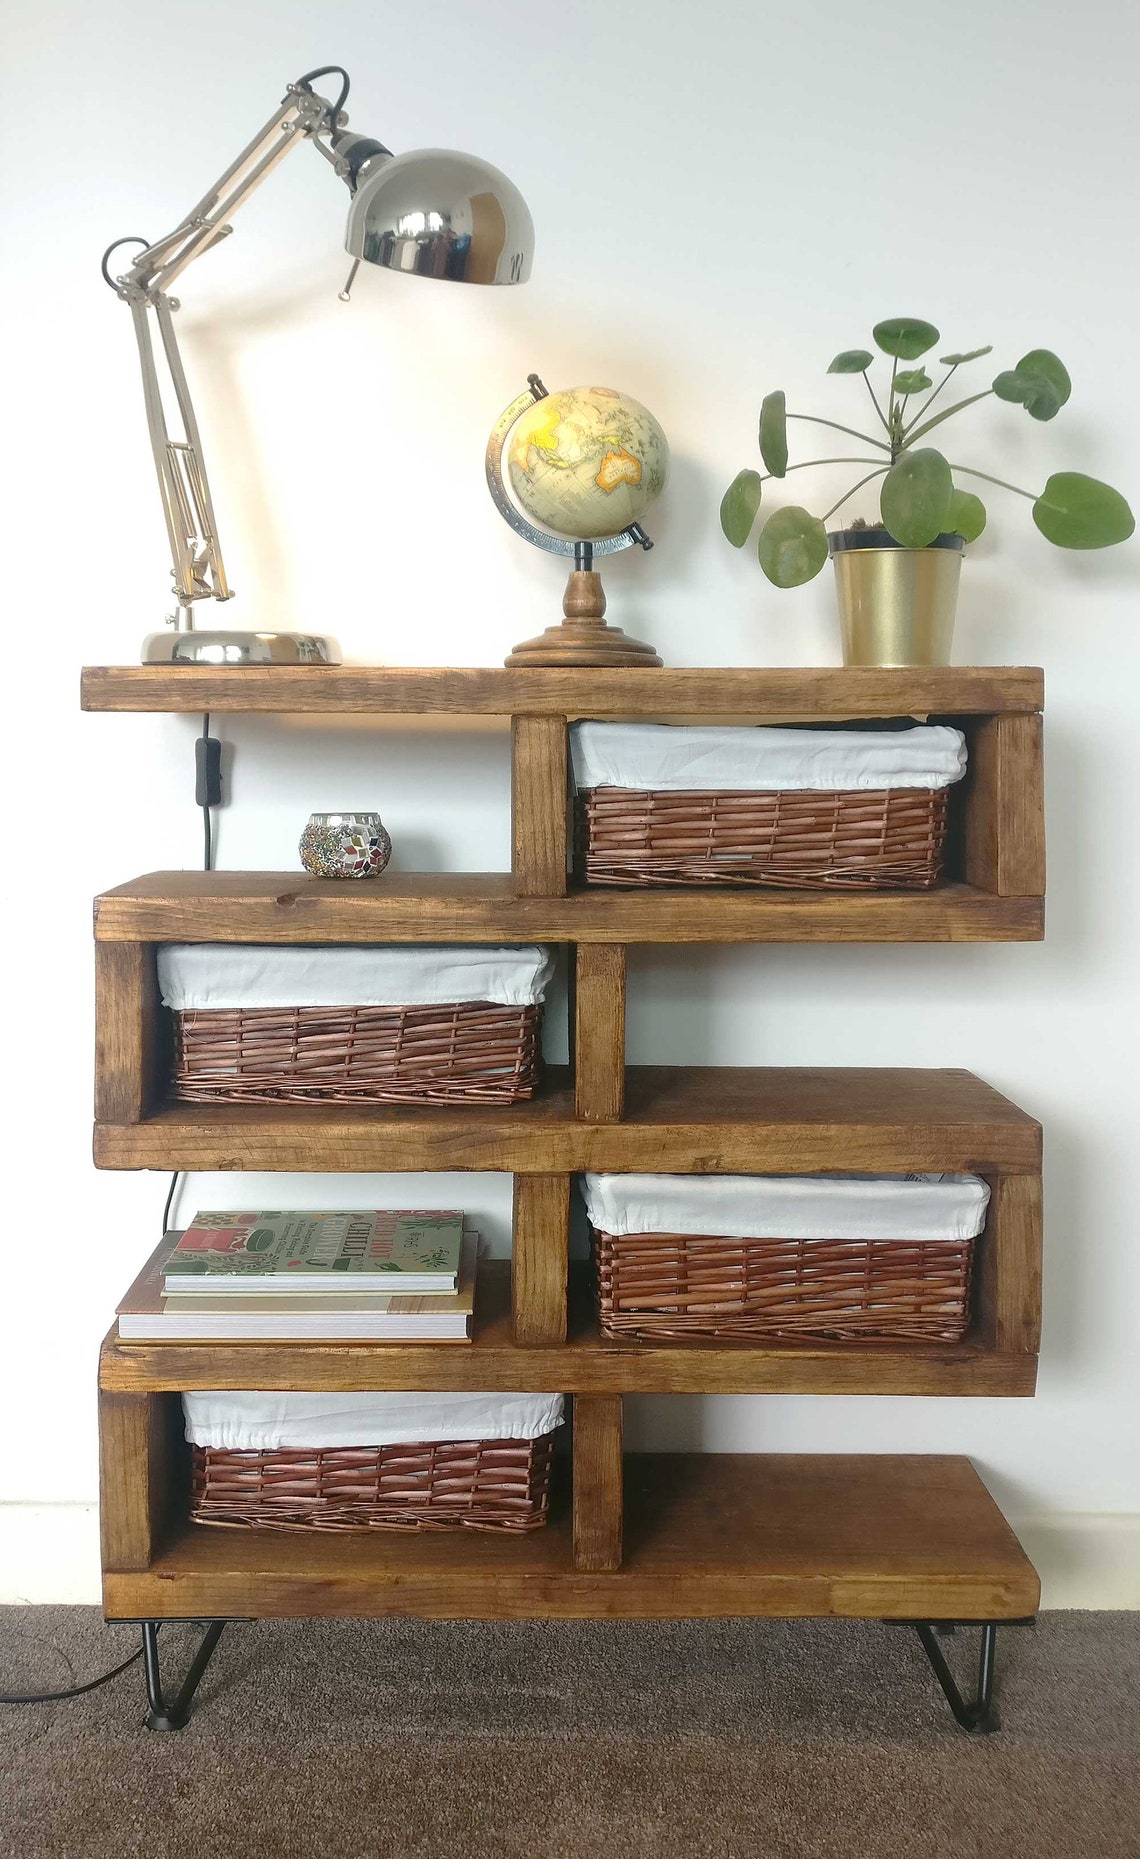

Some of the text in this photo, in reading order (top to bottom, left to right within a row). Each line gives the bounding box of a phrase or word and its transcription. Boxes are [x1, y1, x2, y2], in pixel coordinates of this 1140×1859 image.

[312, 1218, 346, 1259] GROWER
[340, 1222, 373, 1257] CHILLI
[367, 1217, 398, 1259] RED HOT
